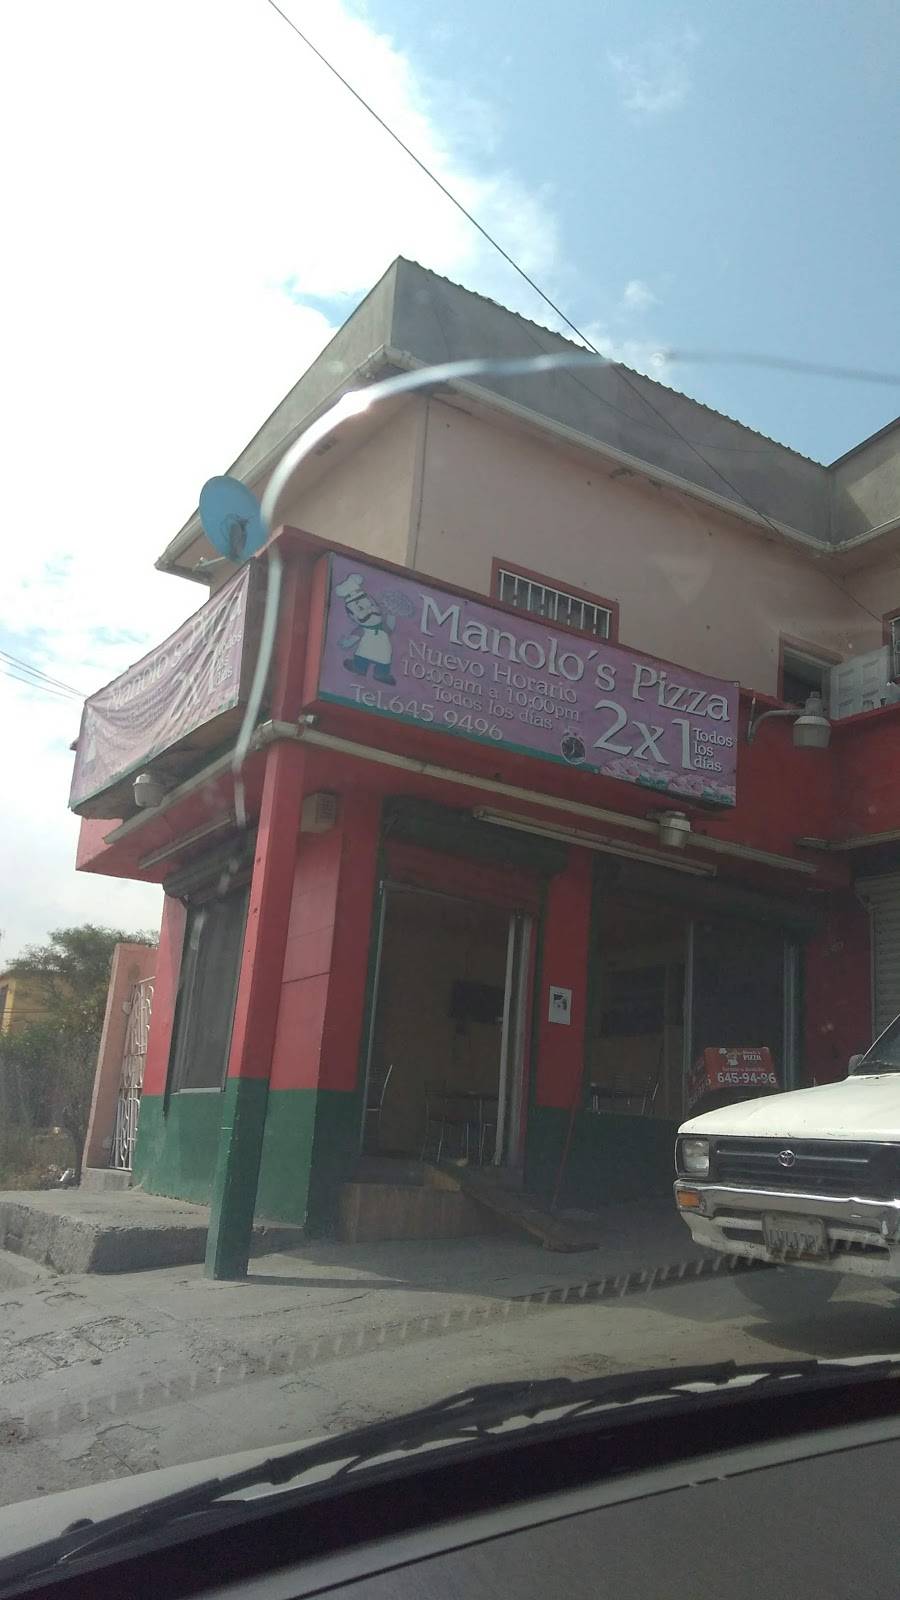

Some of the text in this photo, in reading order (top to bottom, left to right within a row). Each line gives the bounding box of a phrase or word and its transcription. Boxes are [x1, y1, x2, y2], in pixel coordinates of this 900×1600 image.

[408, 640, 578, 703] Nuevo Horario
[402, 659, 580, 721] 10:00am a 10:00pm
[432, 684, 482, 712] Todos
[489, 700, 514, 720] los
[632, 663, 730, 721] Pizza
[444, 710, 503, 741] 9496
[592, 699, 697, 771] 2x1
[692, 727, 734, 748] Todos
[693, 742, 714, 758] los
[717, 1072, 777, 1084] 645-94-96
